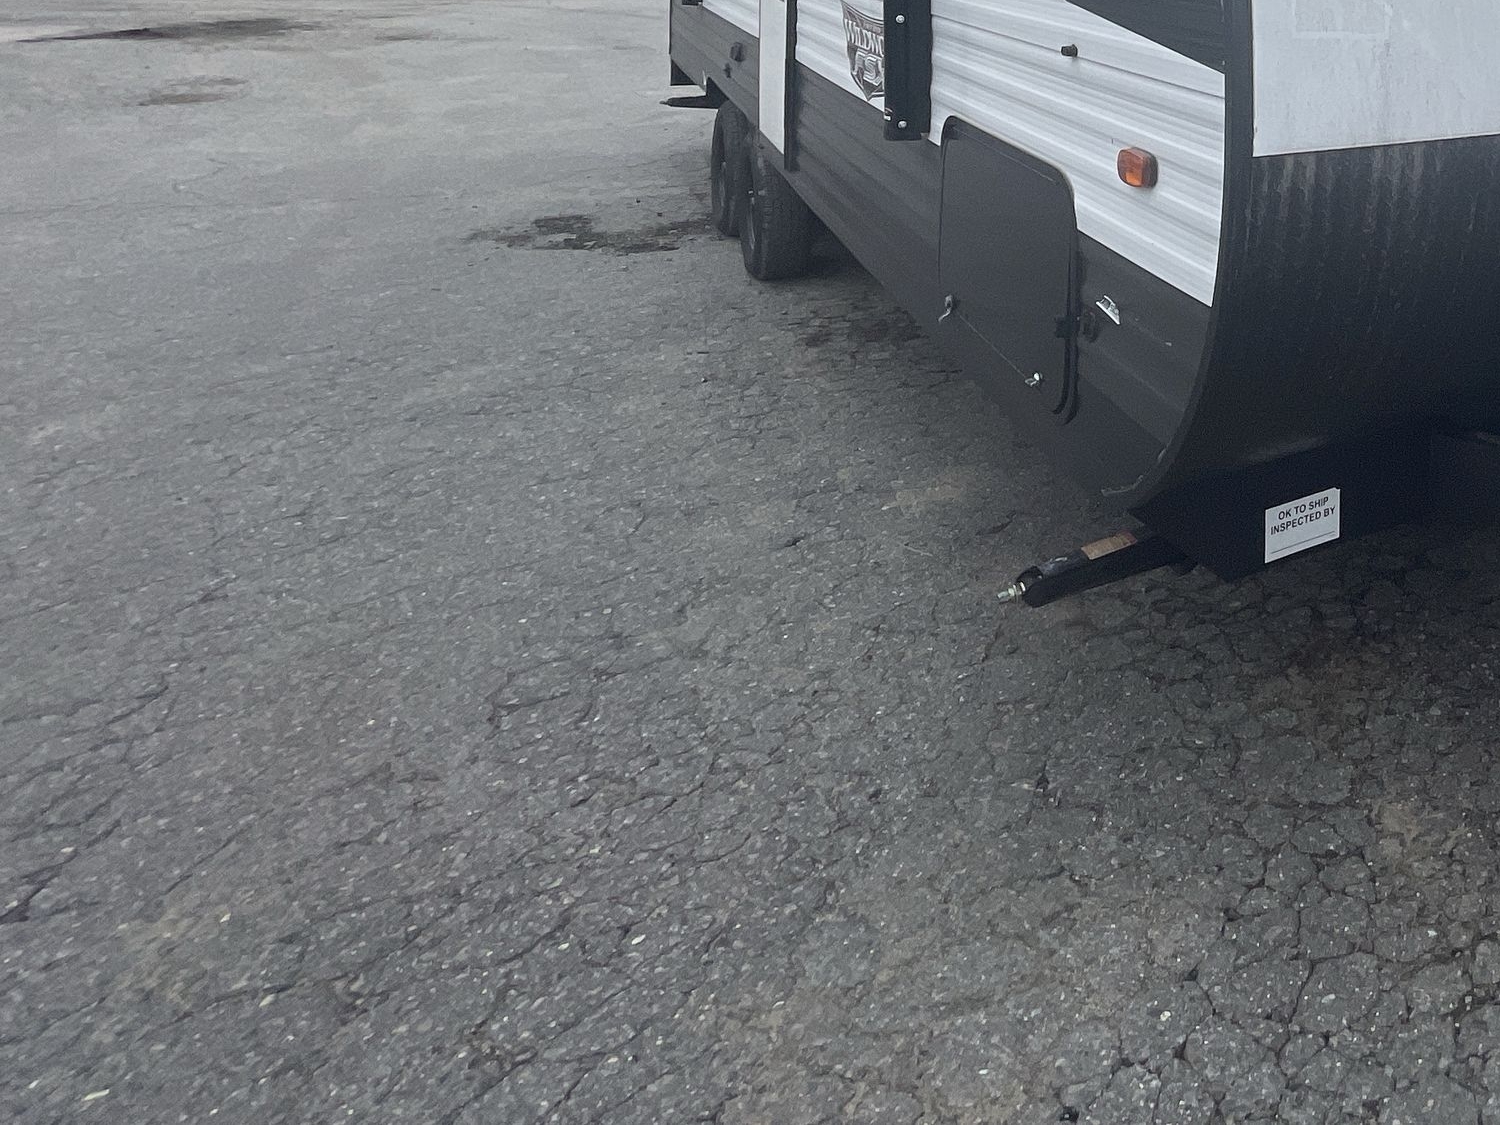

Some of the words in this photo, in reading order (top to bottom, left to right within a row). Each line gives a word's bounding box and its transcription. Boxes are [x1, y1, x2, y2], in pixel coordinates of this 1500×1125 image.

[1270, 511, 1321, 535] INSPECTED
[1323, 506, 1336, 518] BY
[1278, 508, 1292, 521] OK
[1294, 504, 1306, 515] TO
[1308, 496, 1329, 510] SHIP
